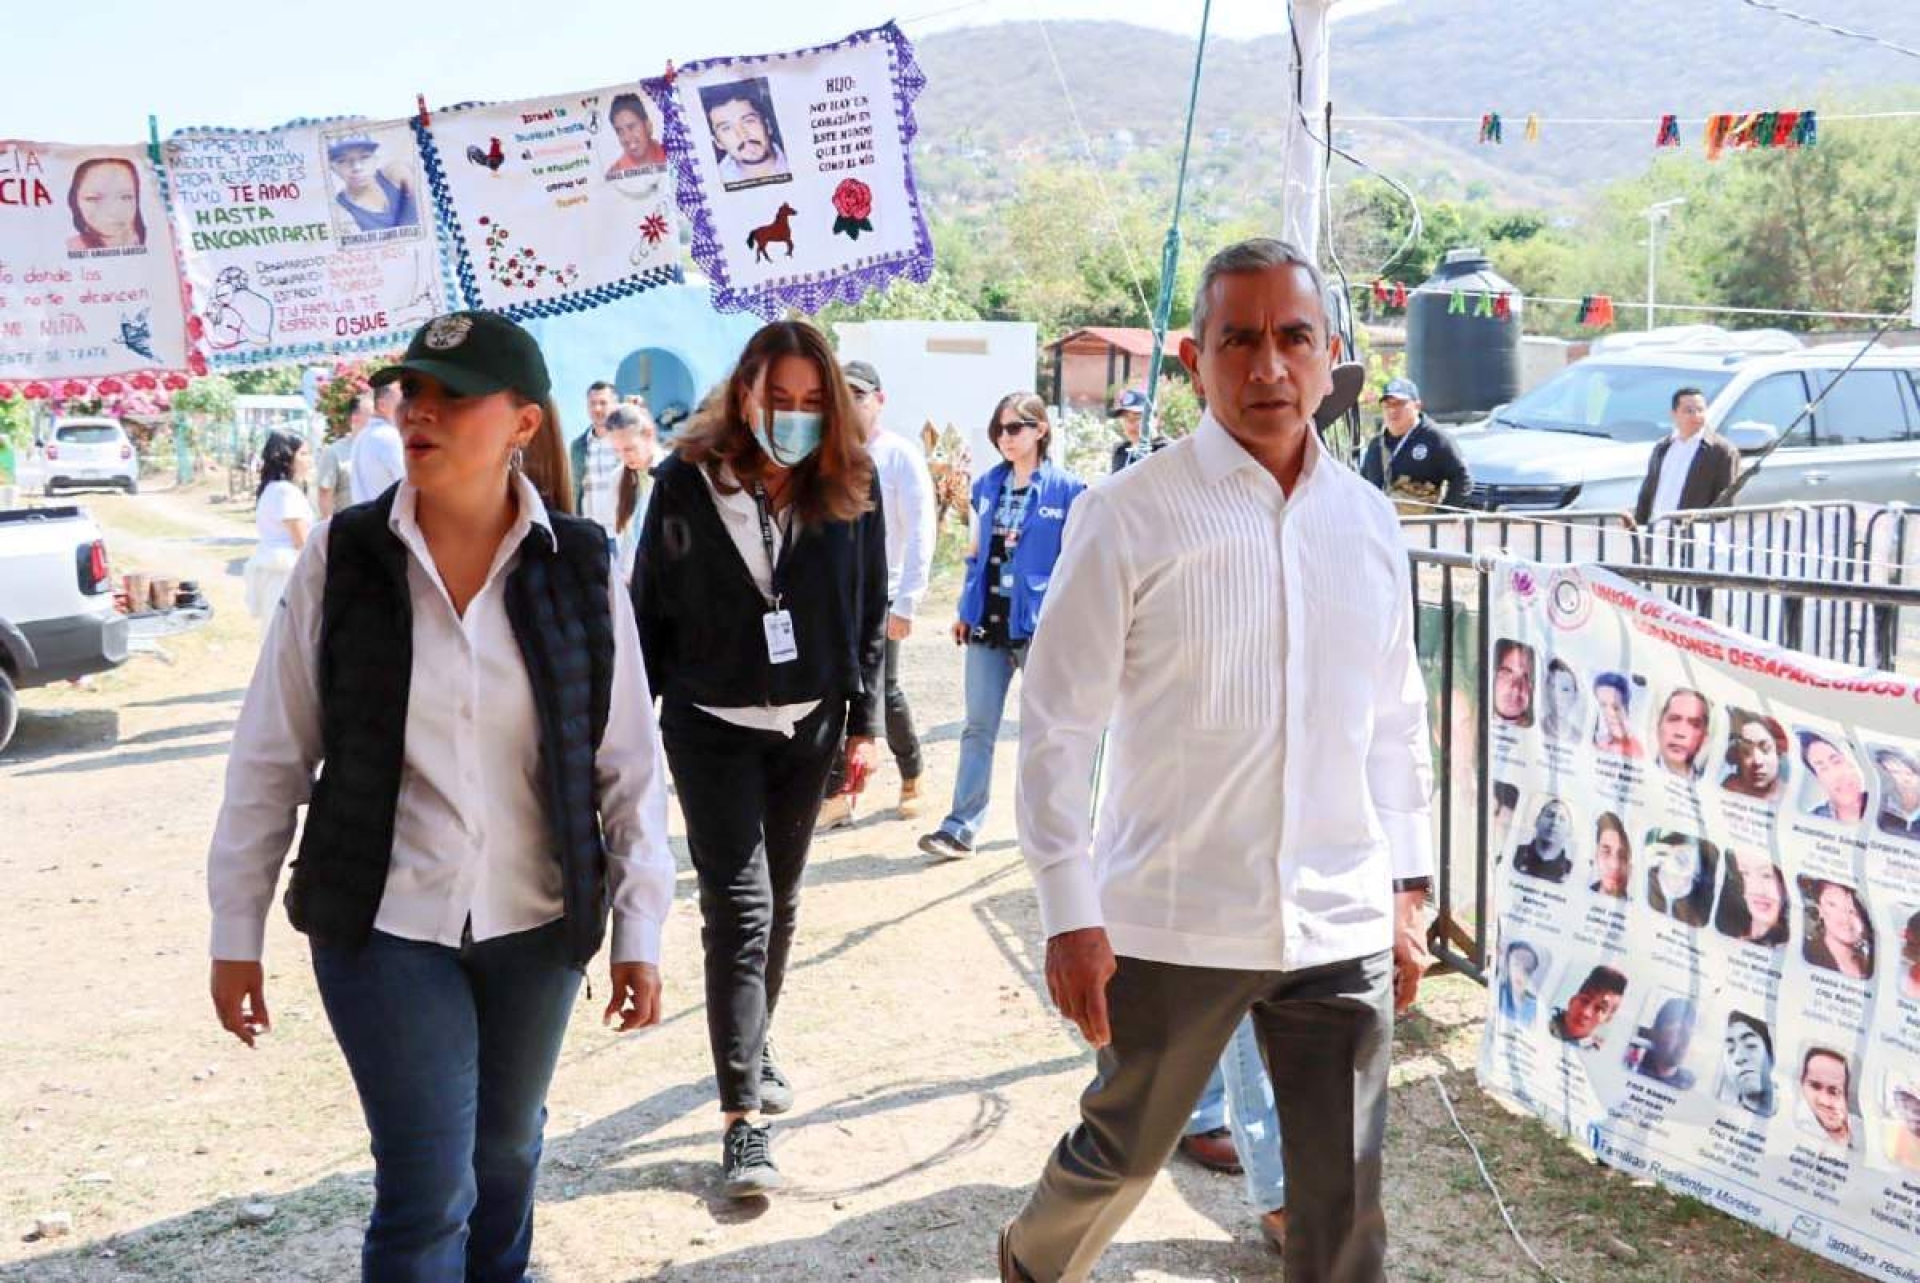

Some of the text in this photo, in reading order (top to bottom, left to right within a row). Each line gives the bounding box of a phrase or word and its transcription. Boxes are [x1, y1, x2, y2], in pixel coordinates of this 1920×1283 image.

[809, 102, 826, 114] NO
[830, 98, 850, 111] HAY
[813, 125, 873, 144] ESTE MUNDO
[815, 140, 872, 159] QUE TE AME
[168, 155, 223, 169] MENTE
[819, 159, 844, 172] COMO
[847, 158, 856, 169] EL
[287, 166, 306, 180] ES
[179, 181, 301, 205] TUYO TE AMO
[194, 205, 275, 226] HASTA
[190, 222, 329, 252] ENCONTRARTE
[23, 264, 72, 284] donde
[277, 305, 298, 318] TU
[1640, 600, 1663, 620] DE
